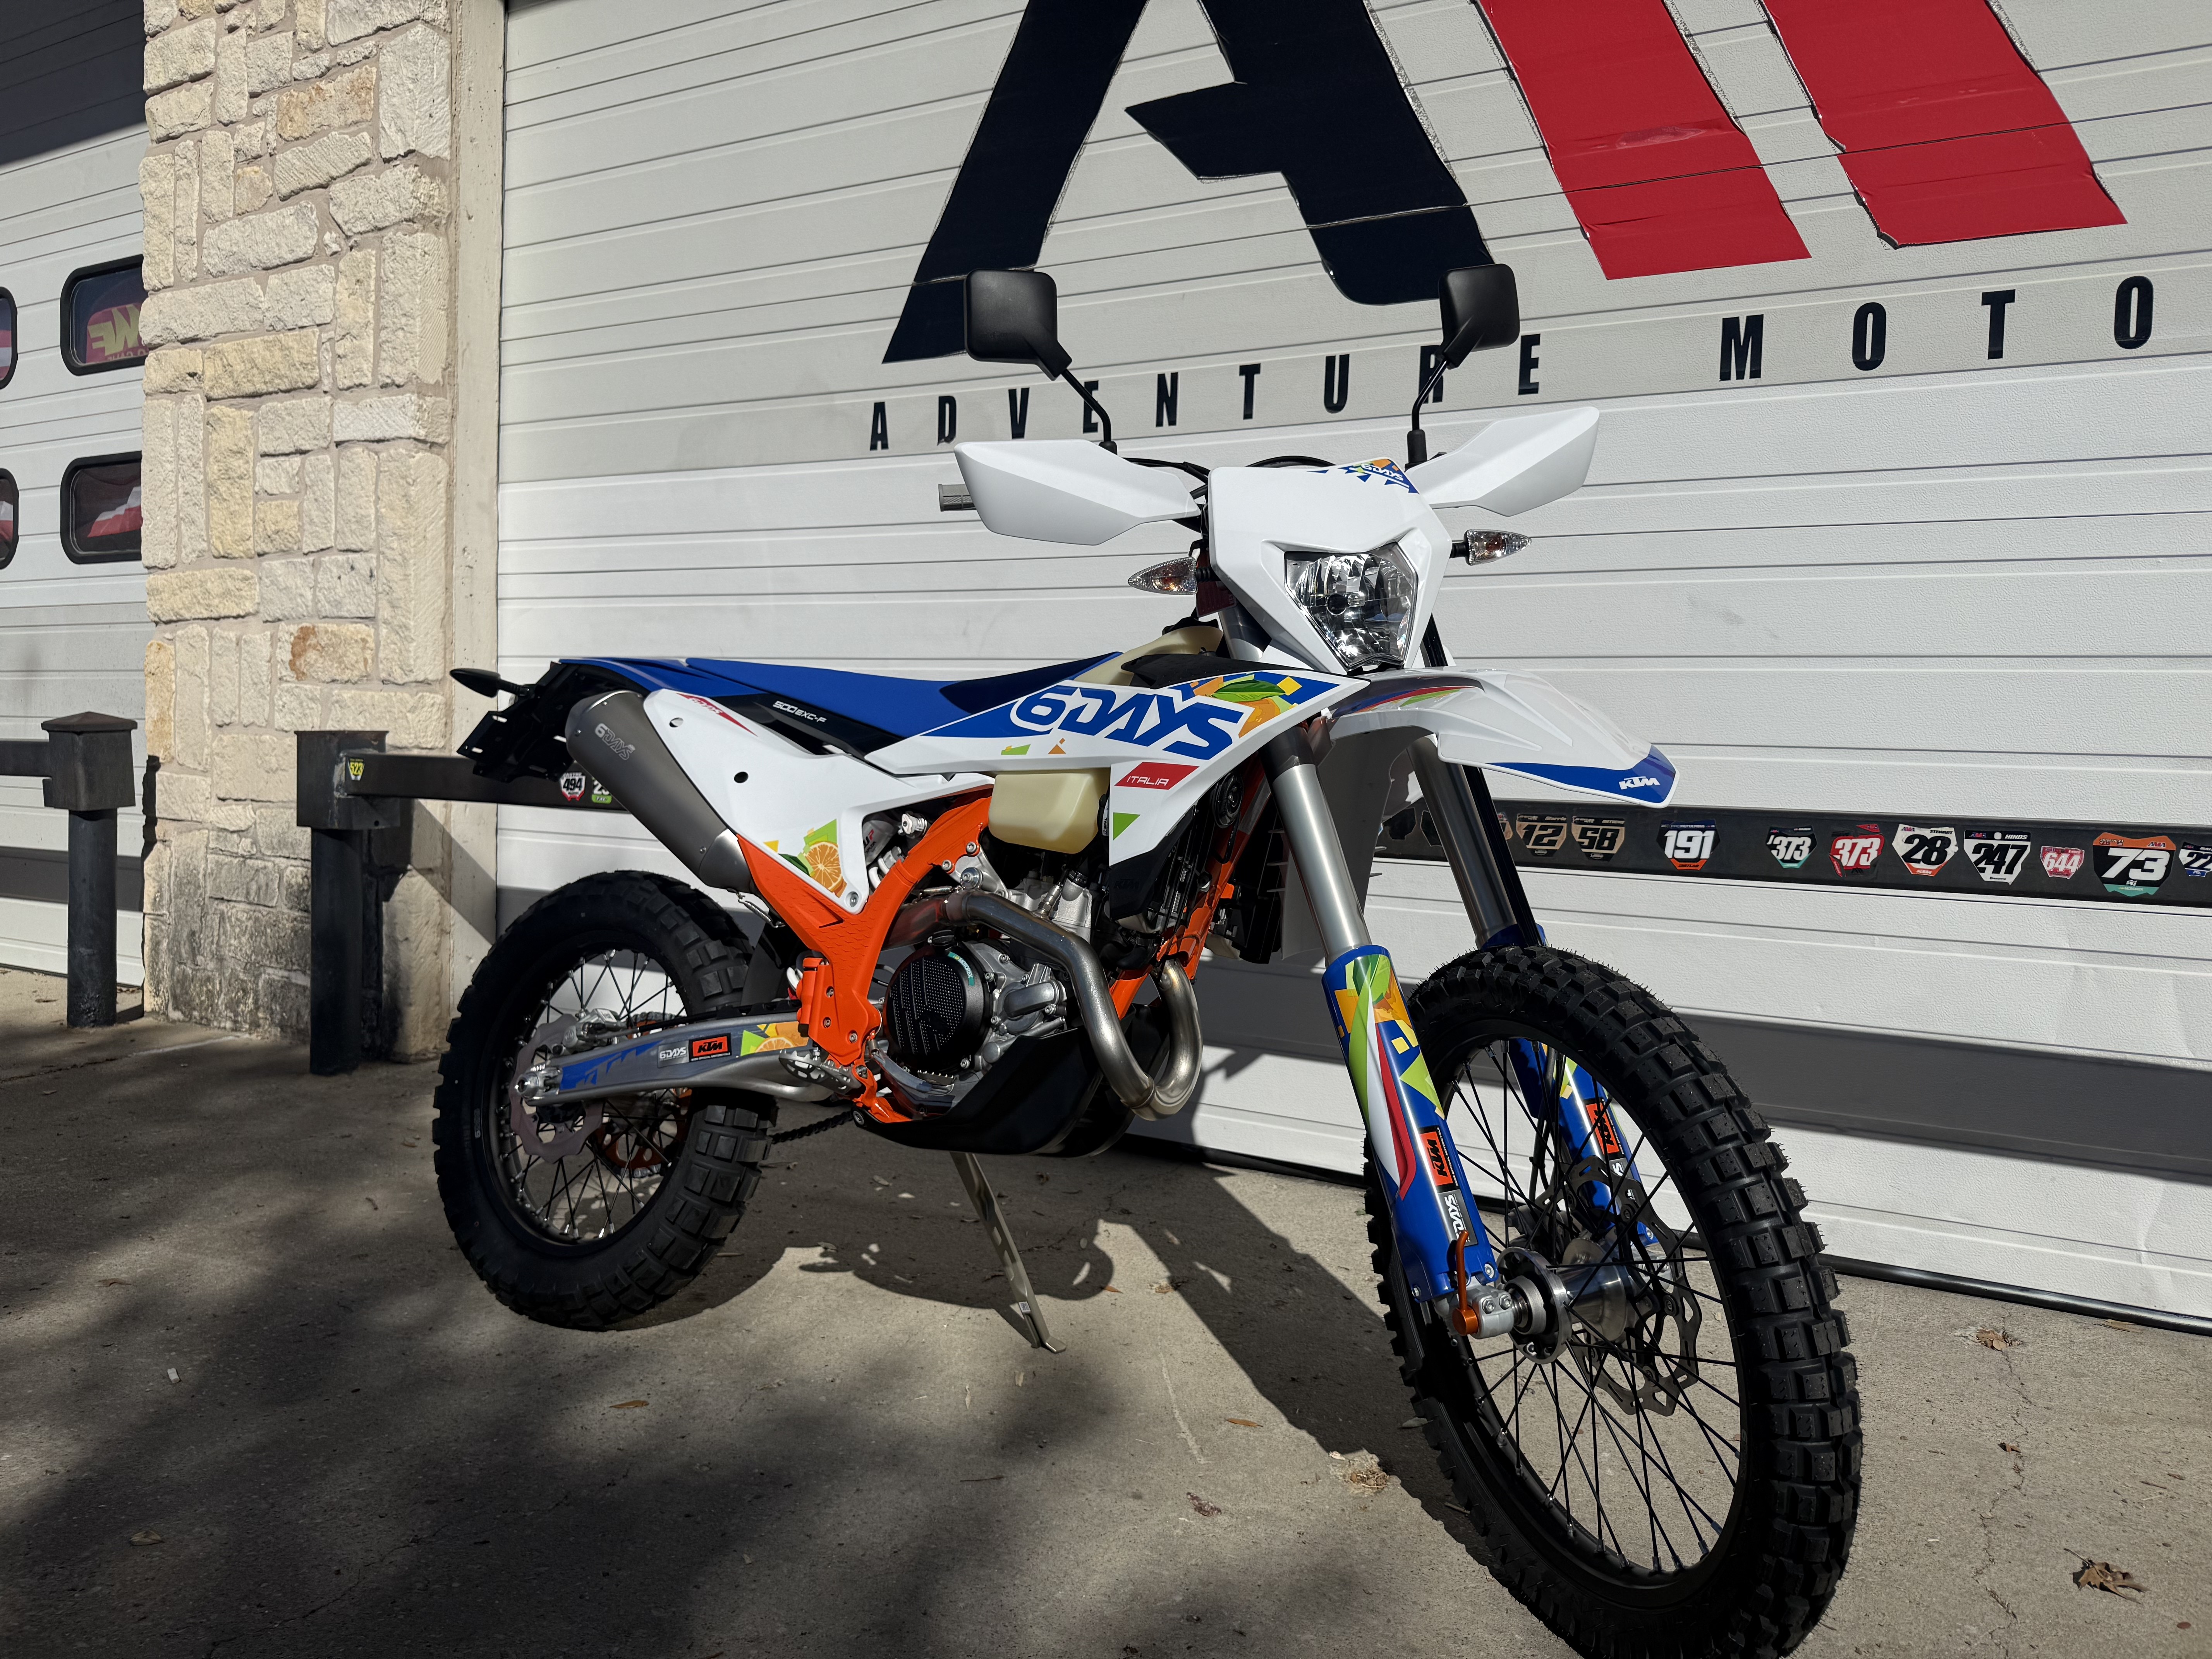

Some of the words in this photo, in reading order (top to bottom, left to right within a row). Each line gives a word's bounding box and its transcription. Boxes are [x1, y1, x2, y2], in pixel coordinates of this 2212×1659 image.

[870, 333, 1541, 452] ADVENTURE
[1719, 276, 2154, 381] MOTO
[1361, 463, 1404, 481] 6DAYS
[1016, 685, 1244, 760] 6DAYS
[595, 723, 634, 760] 6DAYS
[563, 778, 583, 791] 494
[1126, 776, 1170, 786] ITALIA
[1619, 776, 1660, 790] KTM
[1523, 824, 1564, 847] 12
[1577, 827, 1620, 850] 58
[1664, 830, 1715, 859] 191
[1831, 838, 1881, 866] 373
[1901, 834, 1951, 866] 28
[1973, 843, 2028, 874] 247
[2043, 852, 2081, 873] 644
[2101, 847, 2170, 881] 73
[957, 957, 974, 979] MOTOREX
[659, 1047, 686, 1059] 6DAYS
[697, 1041, 723, 1053] KTM
[1427, 1139, 1448, 1177] KTM
